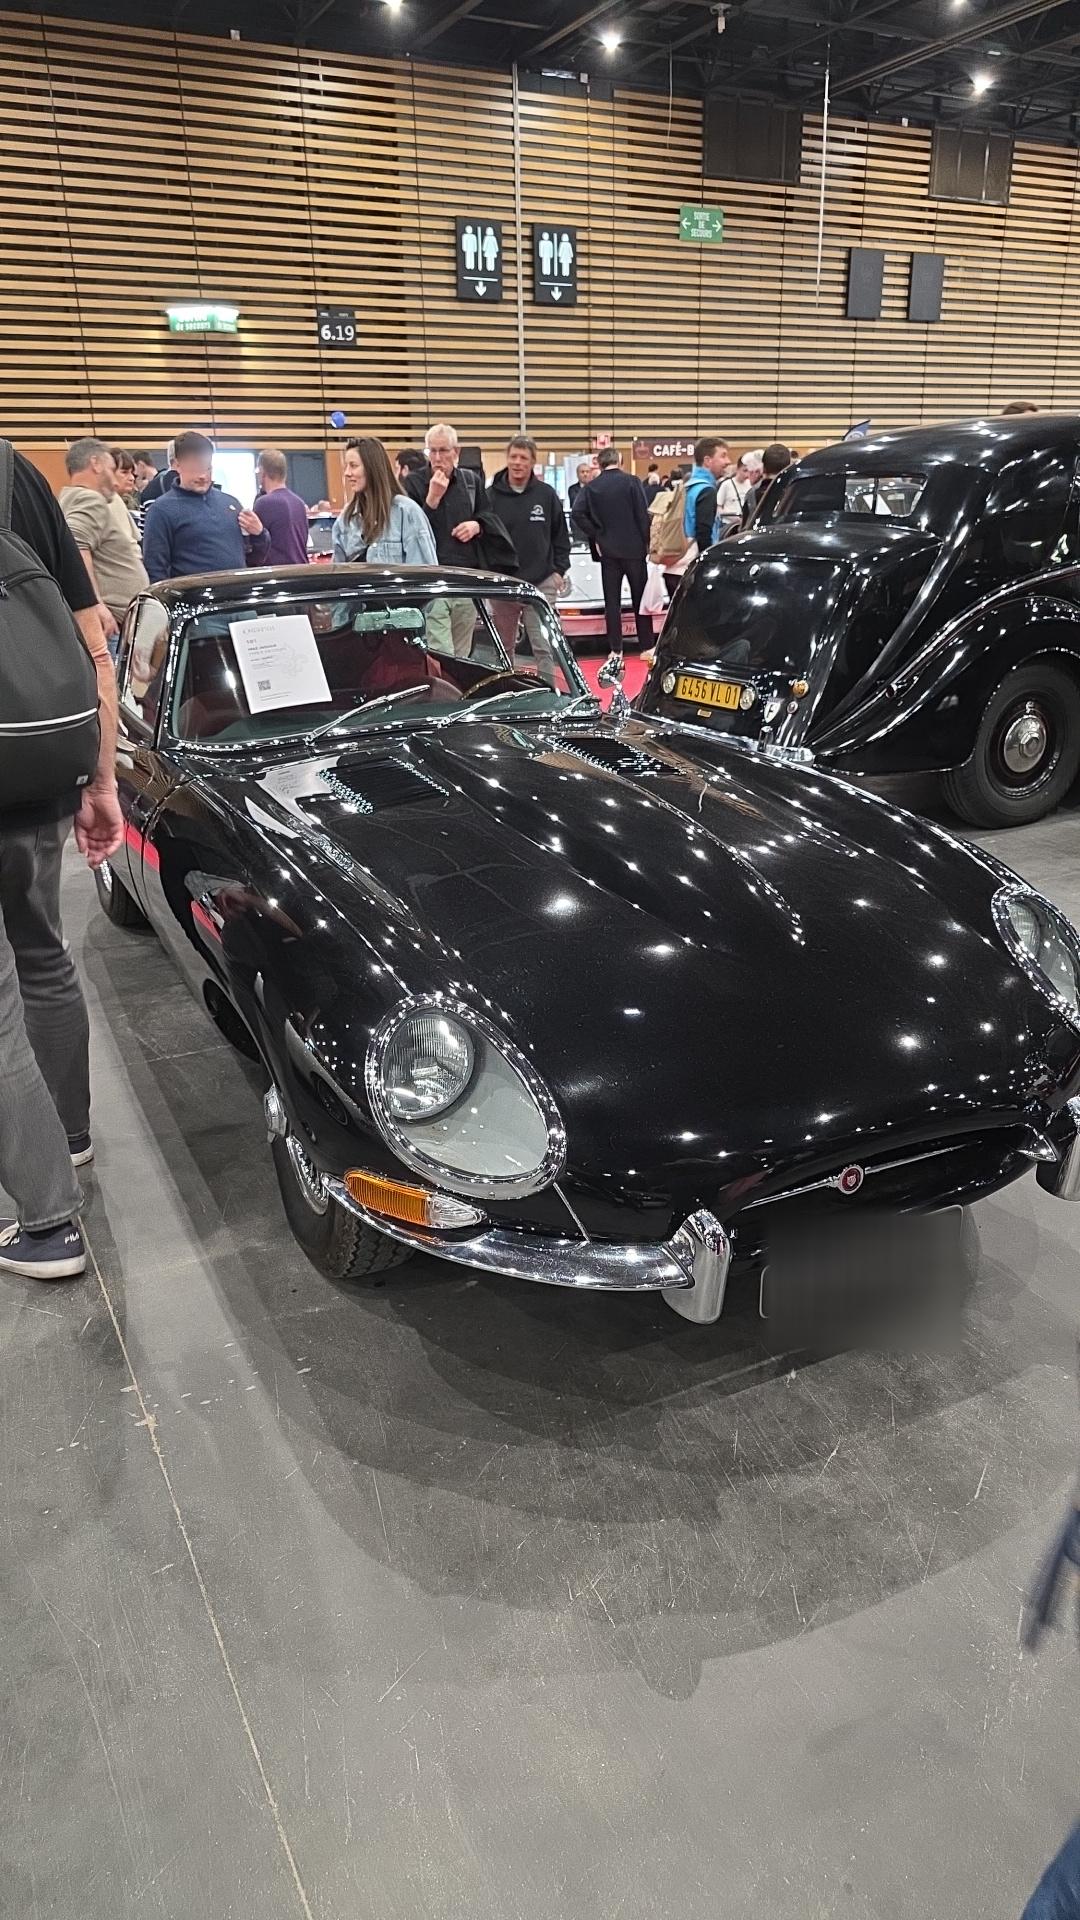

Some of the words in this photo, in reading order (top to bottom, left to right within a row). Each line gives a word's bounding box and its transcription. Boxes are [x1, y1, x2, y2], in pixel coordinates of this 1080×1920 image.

[320, 324, 355, 342] 6.19
[653, 441, 695, 457] CAFÉ-B
[681, 678, 708, 699] 6456
[710, 683, 721, 704] VL
[725, 686, 738, 706] 01
